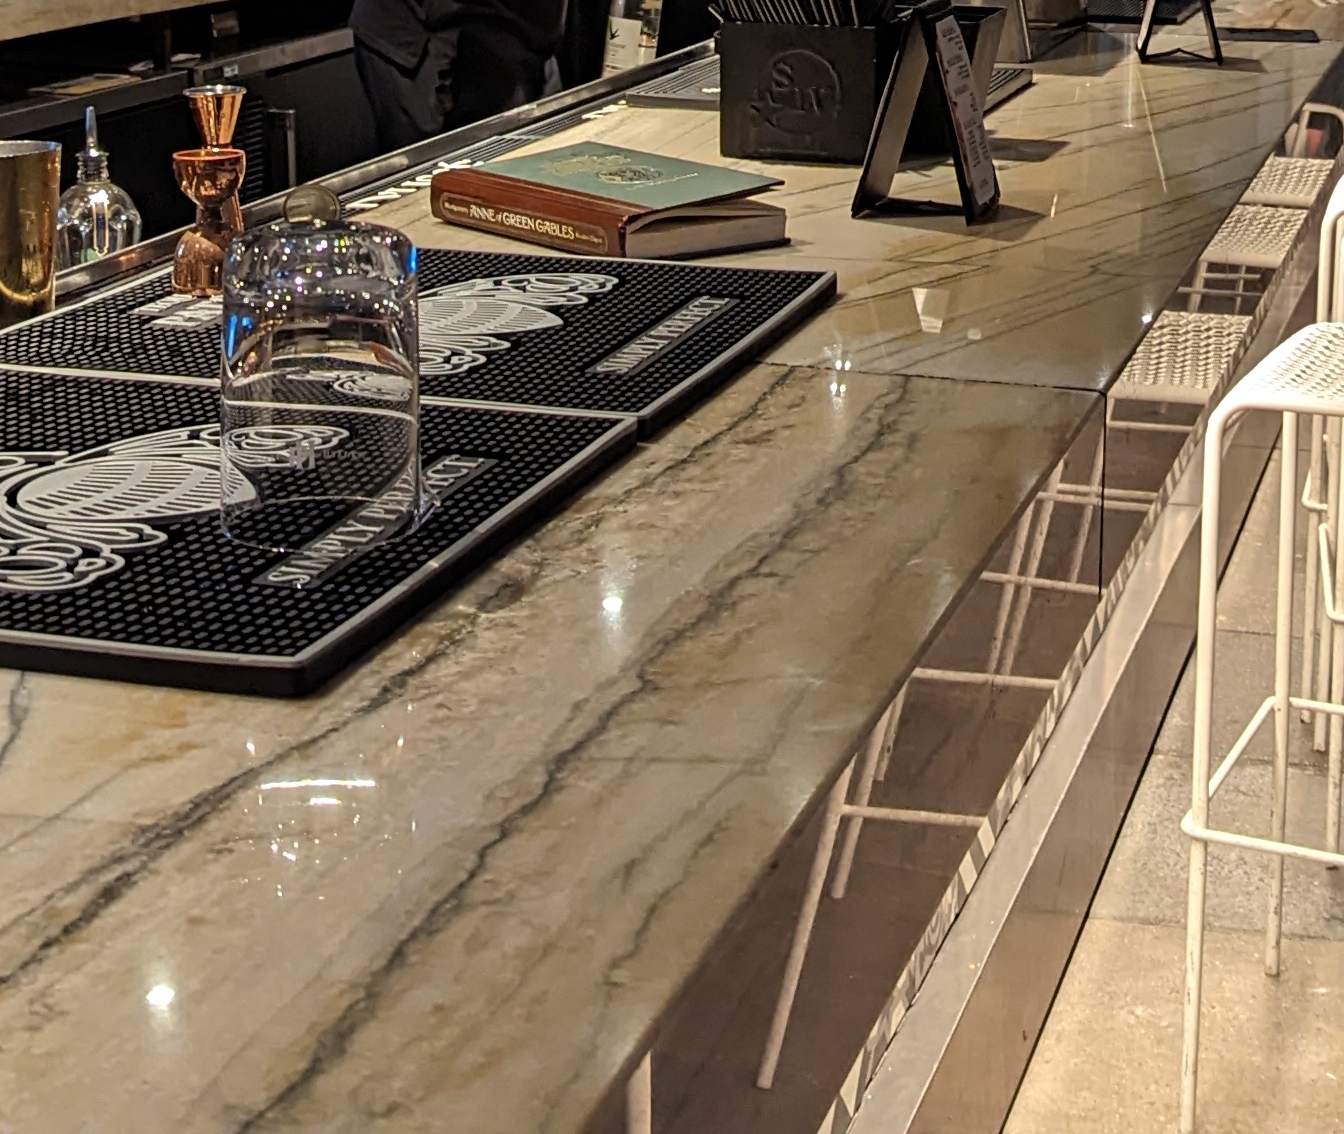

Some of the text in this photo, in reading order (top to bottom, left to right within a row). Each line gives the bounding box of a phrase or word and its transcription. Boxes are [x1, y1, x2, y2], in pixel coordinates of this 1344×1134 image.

[469, 204, 495, 222] ANNE
[502, 211, 535, 231] GREEN
[535, 219, 575, 240] GABLES
[596, 336, 671, 375] SIMPLY
[267, 518, 386, 588] SIMPLY
